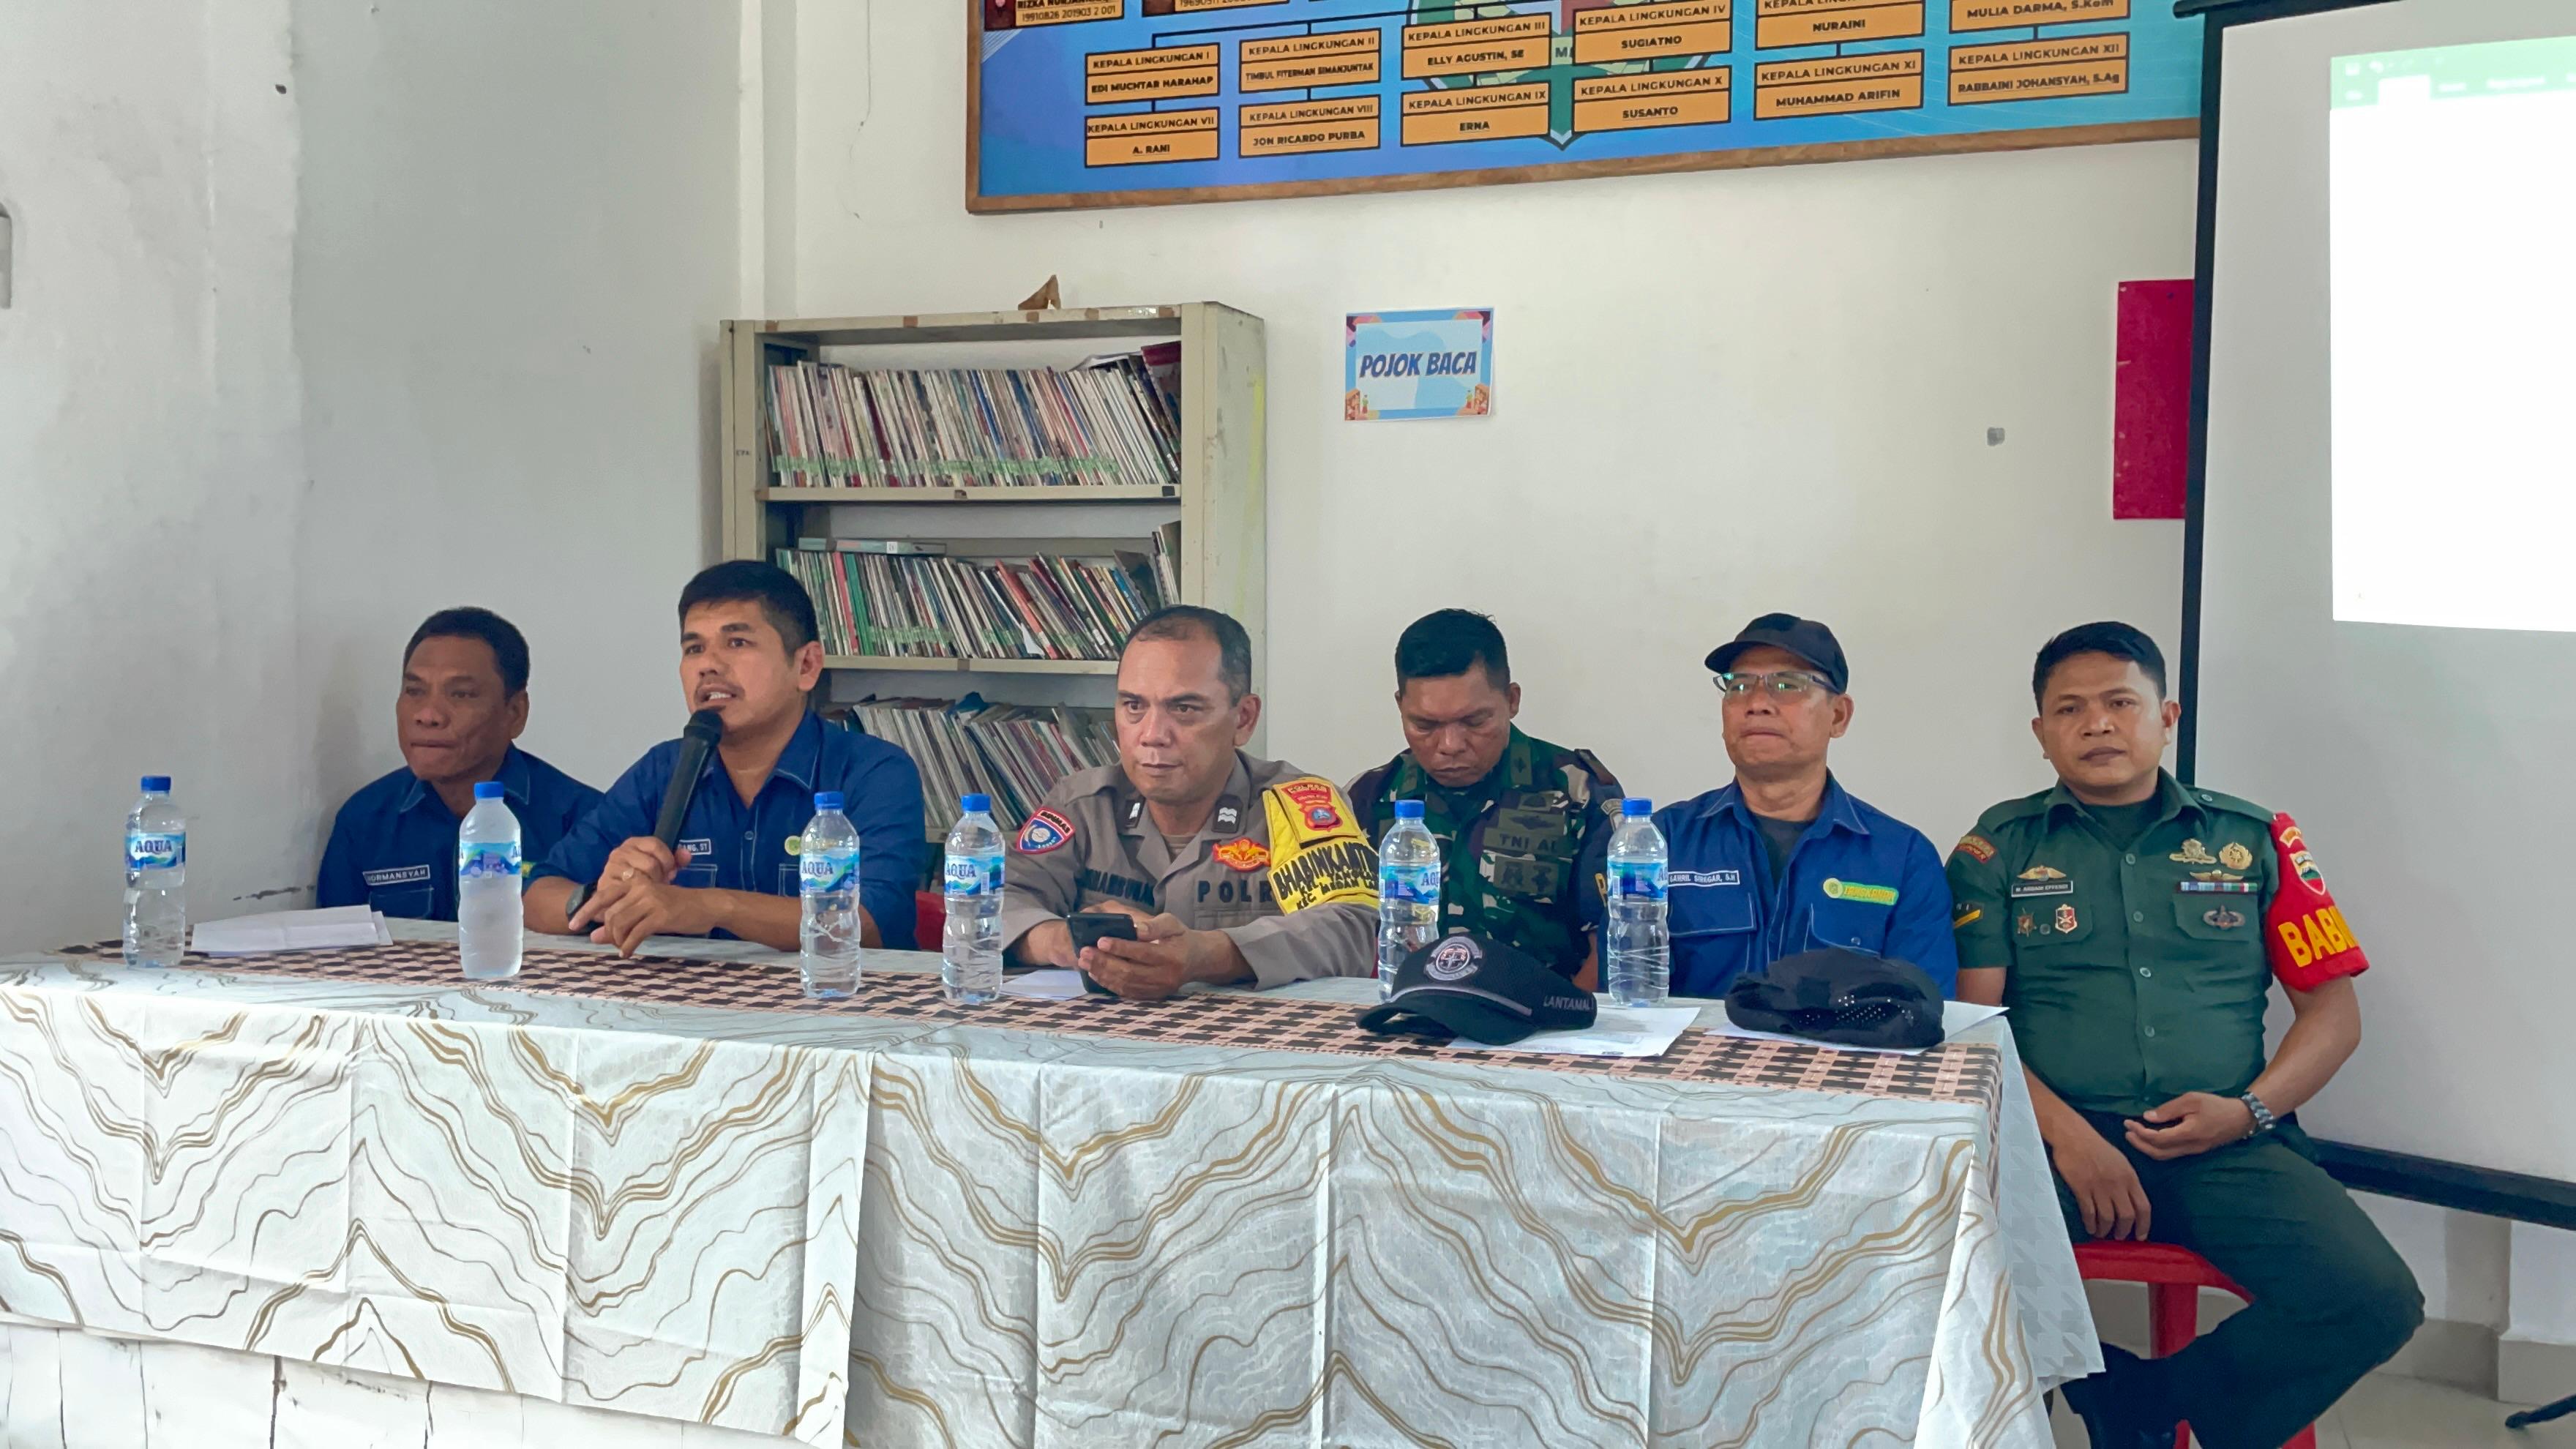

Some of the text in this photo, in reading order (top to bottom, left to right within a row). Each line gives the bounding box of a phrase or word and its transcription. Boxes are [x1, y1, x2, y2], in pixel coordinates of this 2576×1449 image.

[1062, 7, 1091, 18] 201903
[1094, 7, 1098, 15] 2
[1101, 6, 1116, 15] 001
[1579, 4, 1726, 26] KEPALA LINGKUNGAN IV
[1967, 6, 2009, 18] MULIA
[2013, 2, 2067, 15] DARMA,
[1408, 22, 1546, 42] KEPALA LINGKUNGAN III
[1813, 19, 1865, 31] NURAINI
[1248, 45, 1289, 56] KEPALA
[1293, 37, 1365, 52] LINGKUNGAN
[1621, 36, 1682, 49] SUGIATNO
[1093, 59, 1132, 68] KEPALA
[1136, 52, 1202, 65] LINGKUNGAN
[1427, 49, 1524, 66] ELLY AGUSTIN, SE
[1958, 44, 2119, 64] KEPALA LINGKUNGAN XII
[1761, 60, 1916, 81] KEPALA LINGKUNGAN XI
[1091, 76, 1213, 93] EDI MUCHTAR HARAHAP
[1581, 76, 1723, 96] KEPALA LINGKUNGAN X
[1409, 90, 1546, 109] KEPALA LINGKUNGAN IX
[1776, 89, 1901, 107] MUHAMMAD ARIFIN
[1250, 104, 1373, 121] KEPALA LINGKUNGAN VIII
[1622, 106, 1678, 119] SUSANTO
[1088, 123, 1127, 133] KEPALA
[1130, 117, 1197, 130] LINGKUNGAN
[1459, 121, 1490, 131] ERNA
[1253, 131, 1366, 146] JON RICARDO PURBA
[1132, 144, 1170, 154] A. RANI
[1359, 351, 1477, 378] POJOK BACA
[135, 839, 173, 855] AQUA
[1499, 833, 1531, 849] TNI
[802, 861, 834, 877] AQUA
[946, 862, 977, 880] AQUA
[1197, 880, 1273, 903] POLR
